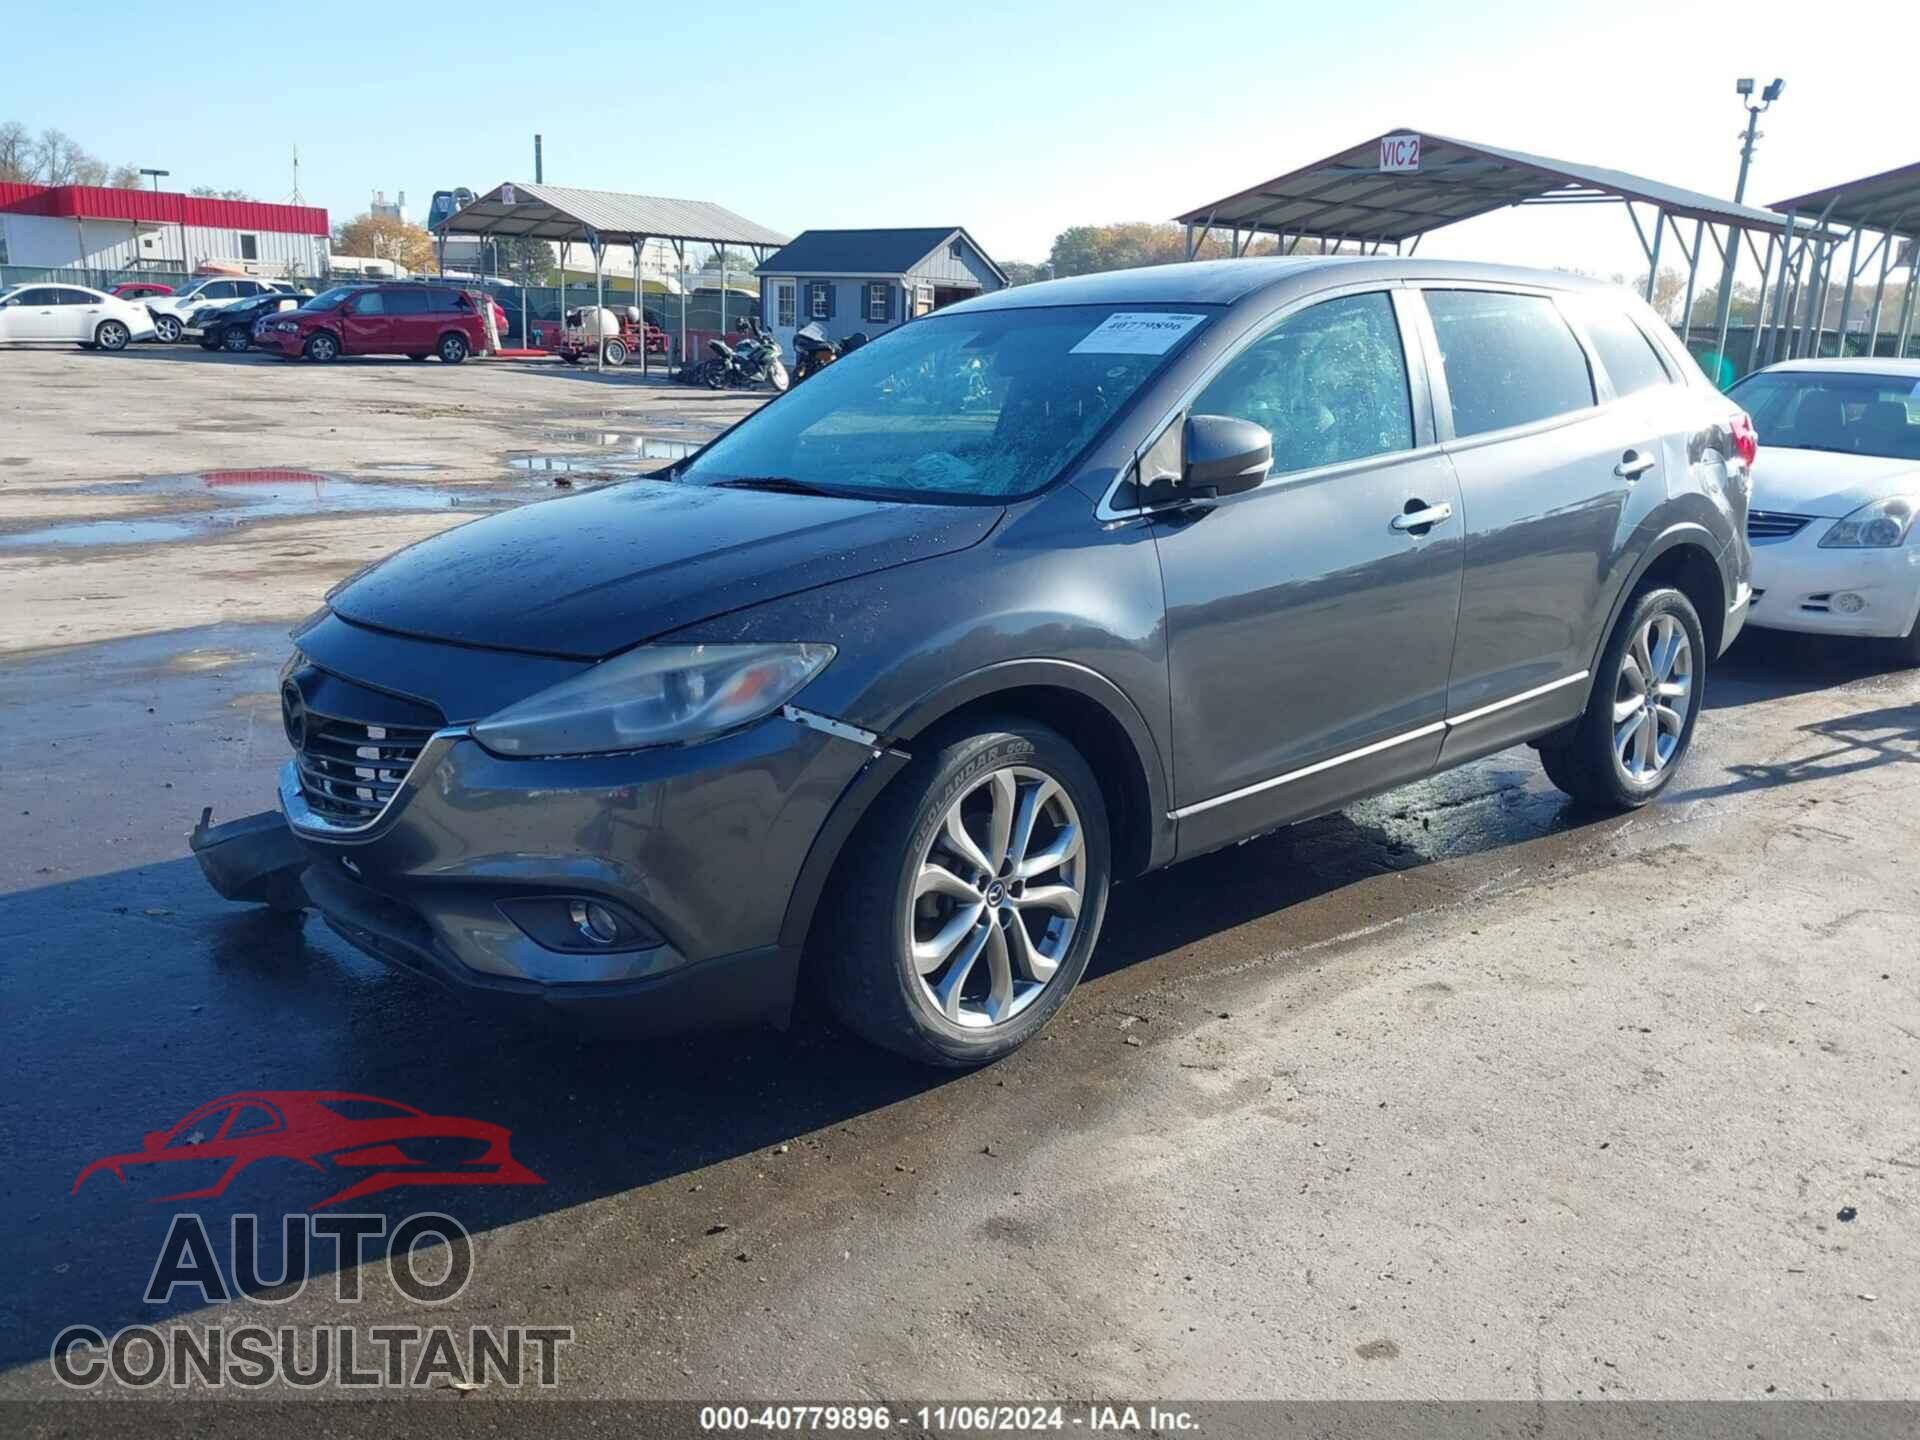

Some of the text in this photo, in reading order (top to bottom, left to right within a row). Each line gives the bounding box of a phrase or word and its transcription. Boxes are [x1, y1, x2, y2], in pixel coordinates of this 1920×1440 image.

[1381, 140, 1418, 167] VIC 2
[913, 746, 1000, 853] GEOLANDAR
